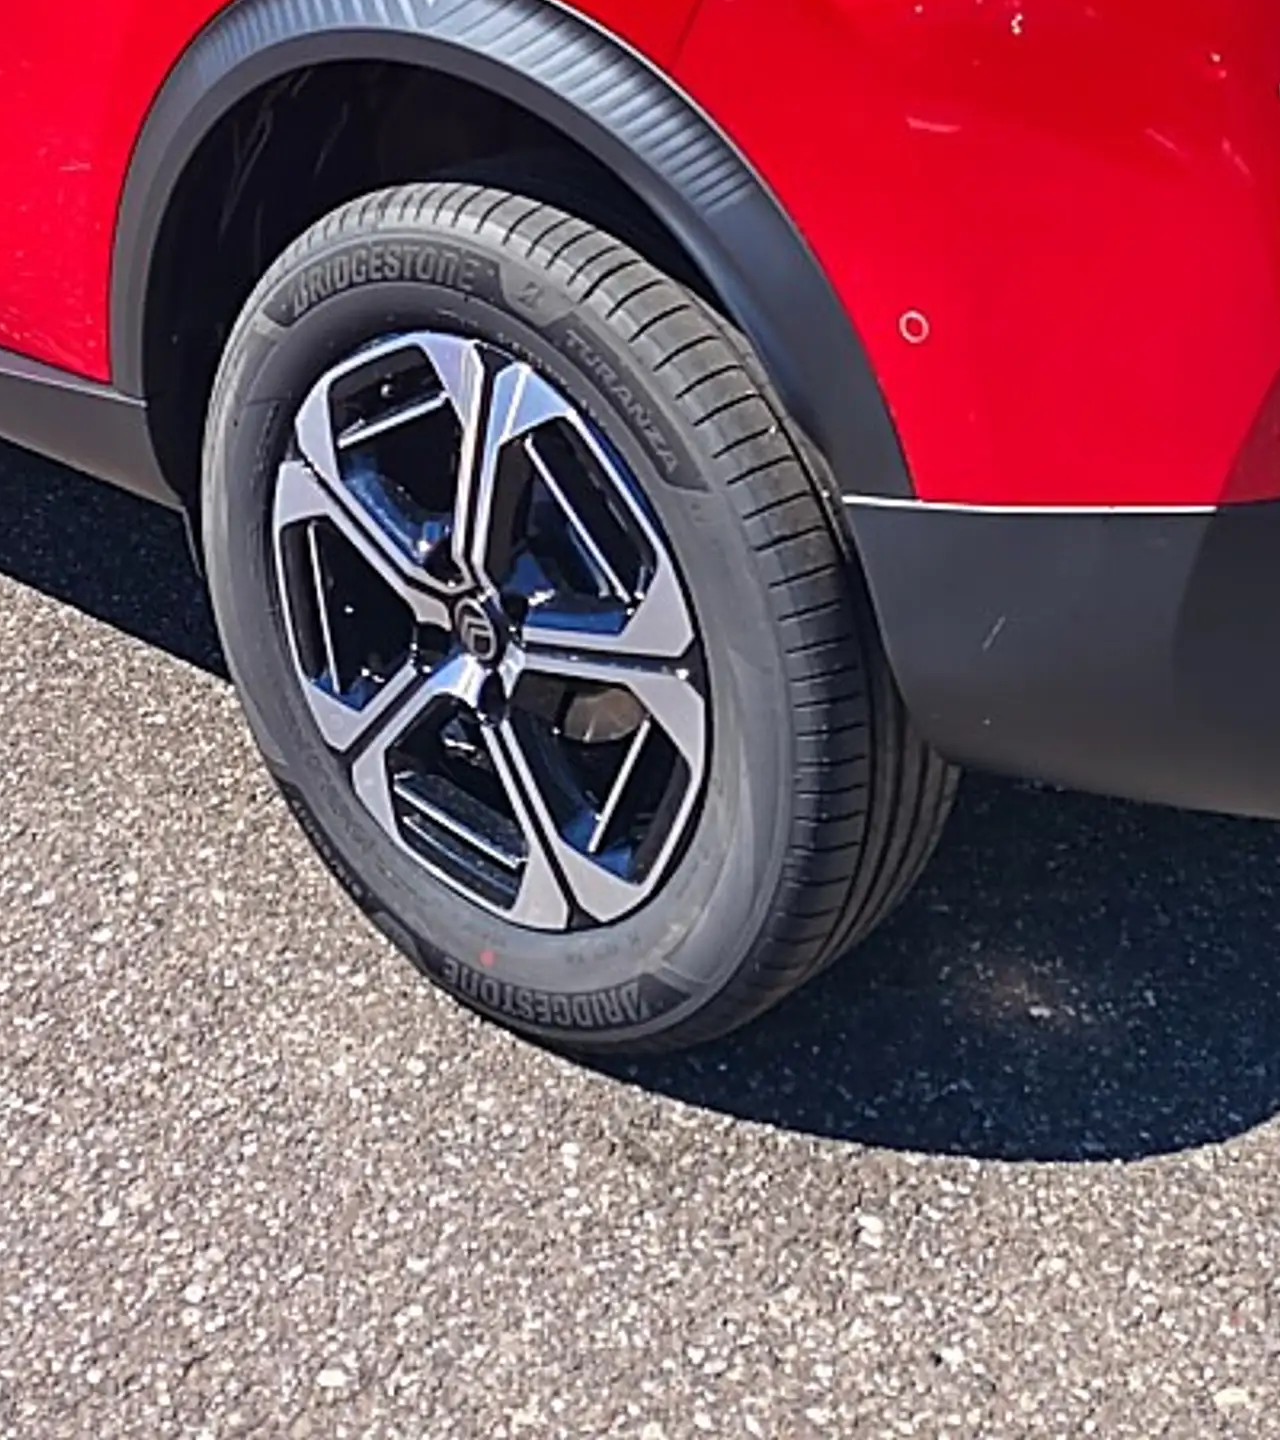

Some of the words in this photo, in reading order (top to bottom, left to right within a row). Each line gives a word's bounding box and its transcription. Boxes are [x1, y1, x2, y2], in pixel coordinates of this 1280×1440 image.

[292, 244, 481, 318] BRIDGESTONE
[565, 329, 678, 475] TURANZA
[442, 955, 651, 1028] BRIDGESTONE
